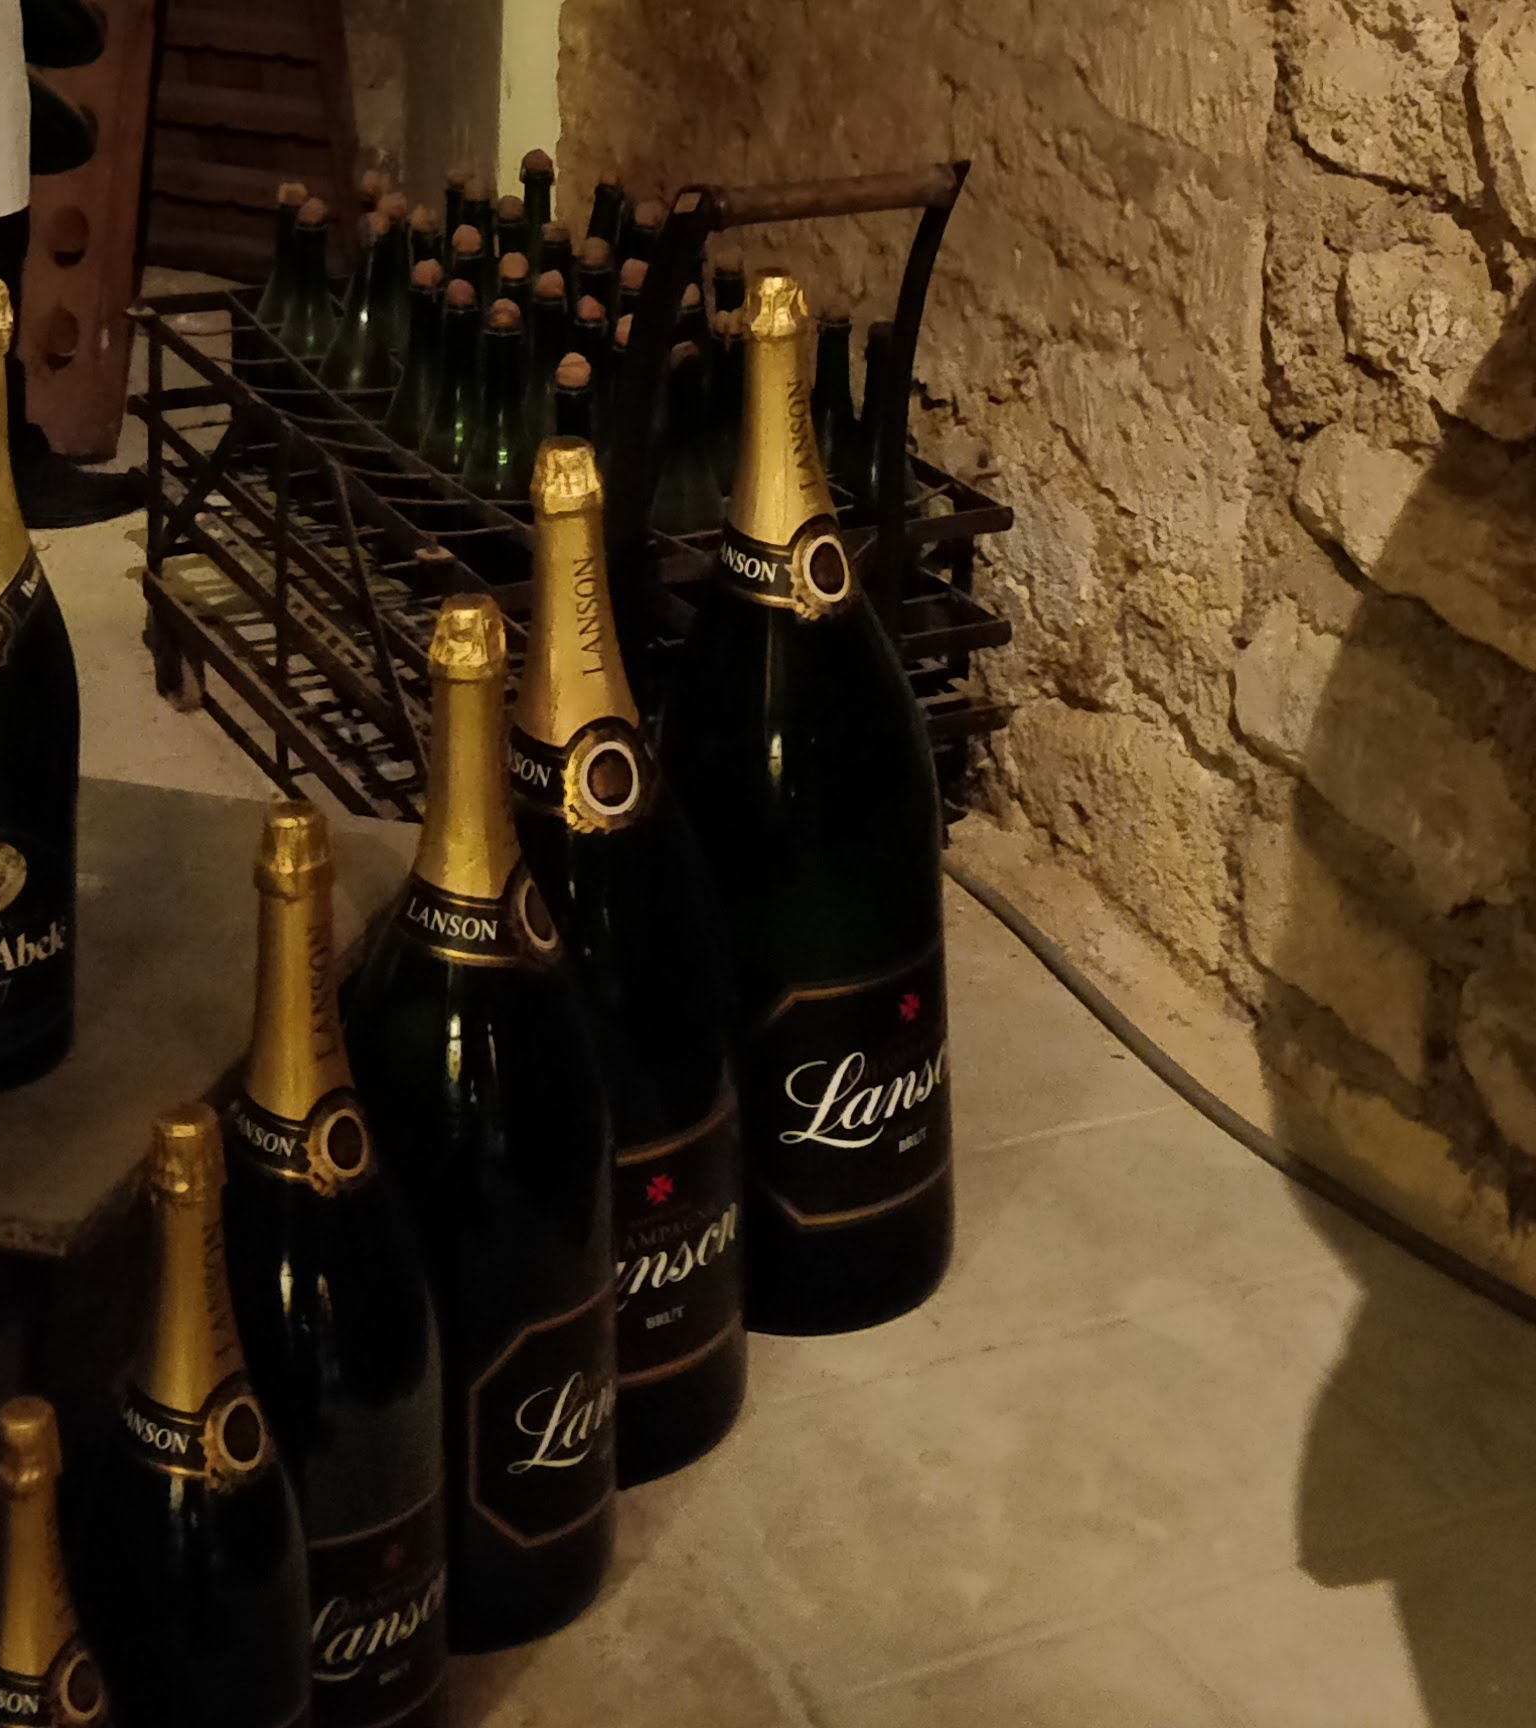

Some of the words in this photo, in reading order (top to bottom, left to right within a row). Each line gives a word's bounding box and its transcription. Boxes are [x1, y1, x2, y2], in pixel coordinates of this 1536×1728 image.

[786, 379, 818, 491] LANSON
[720, 540, 778, 583] ANSON
[572, 556, 605, 677] LANSON
[406, 896, 499, 942] LANSON
